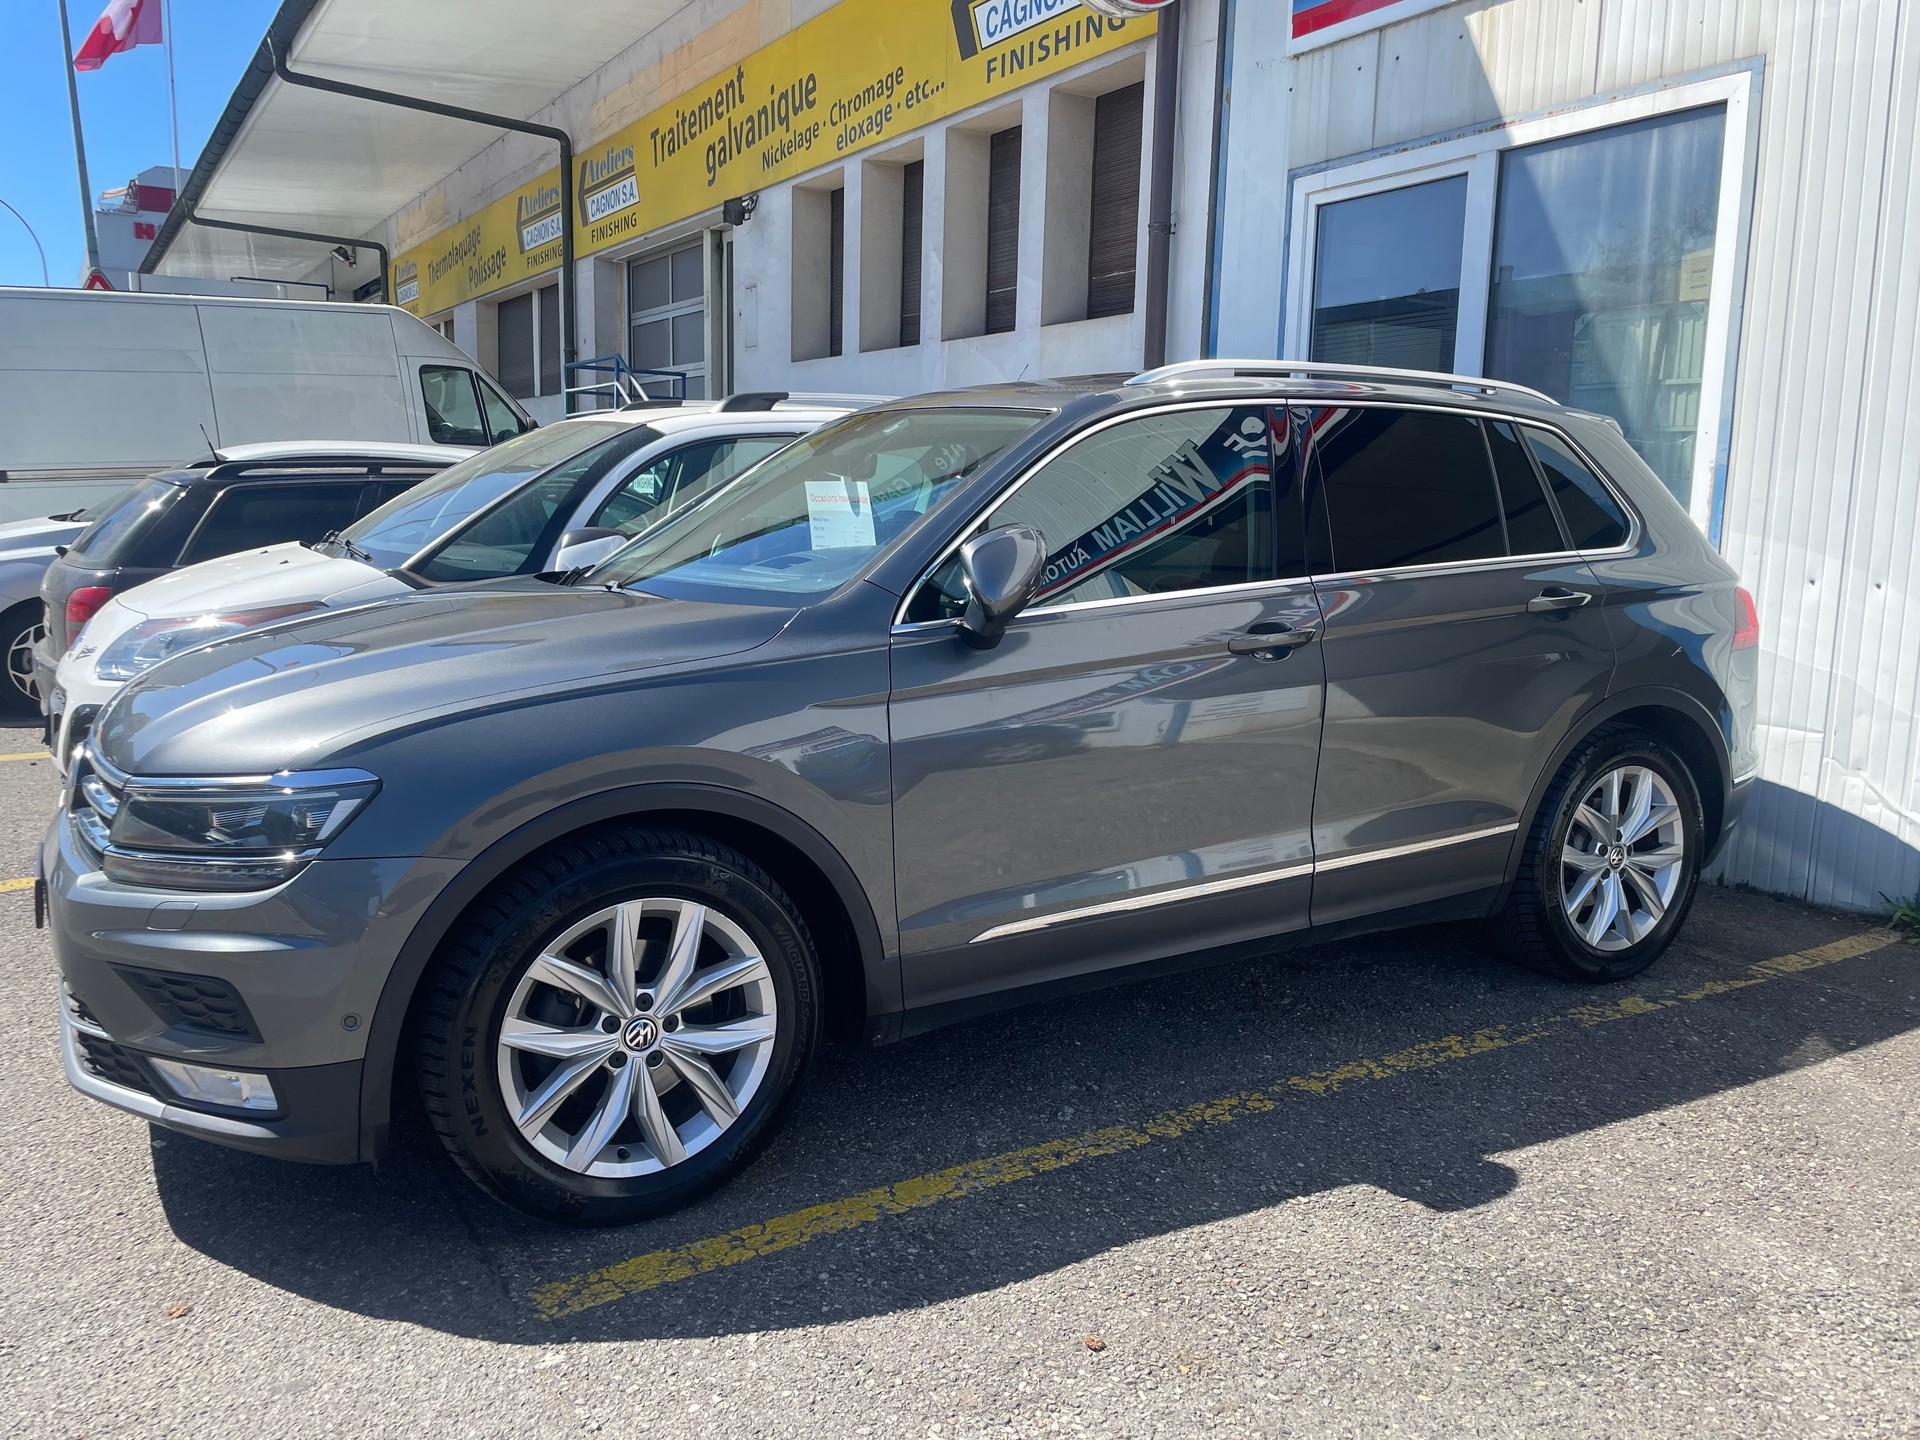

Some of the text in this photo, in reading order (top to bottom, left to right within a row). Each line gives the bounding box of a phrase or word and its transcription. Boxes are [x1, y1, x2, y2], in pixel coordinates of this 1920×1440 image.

[986, 0, 1064, 38] CAGN
[650, 65, 744, 167] Traitement
[705, 73, 817, 187] galvanique
[762, 66, 904, 172] Nickelage Chromage
[836, 78, 945, 151] eloxage etc...
[588, 145, 634, 183] Ateliers
[524, 185, 560, 216] Ateliers
[590, 181, 637, 218] CAGNON S.A.
[526, 222, 549, 247] CAGNON
[591, 212, 637, 244] FINISHING
[427, 225, 481, 287] Thermolaquage
[468, 245, 506, 292] Polissage
[526, 244, 562, 269] FINISHING
[461, 1026, 489, 1137] NEXEN
